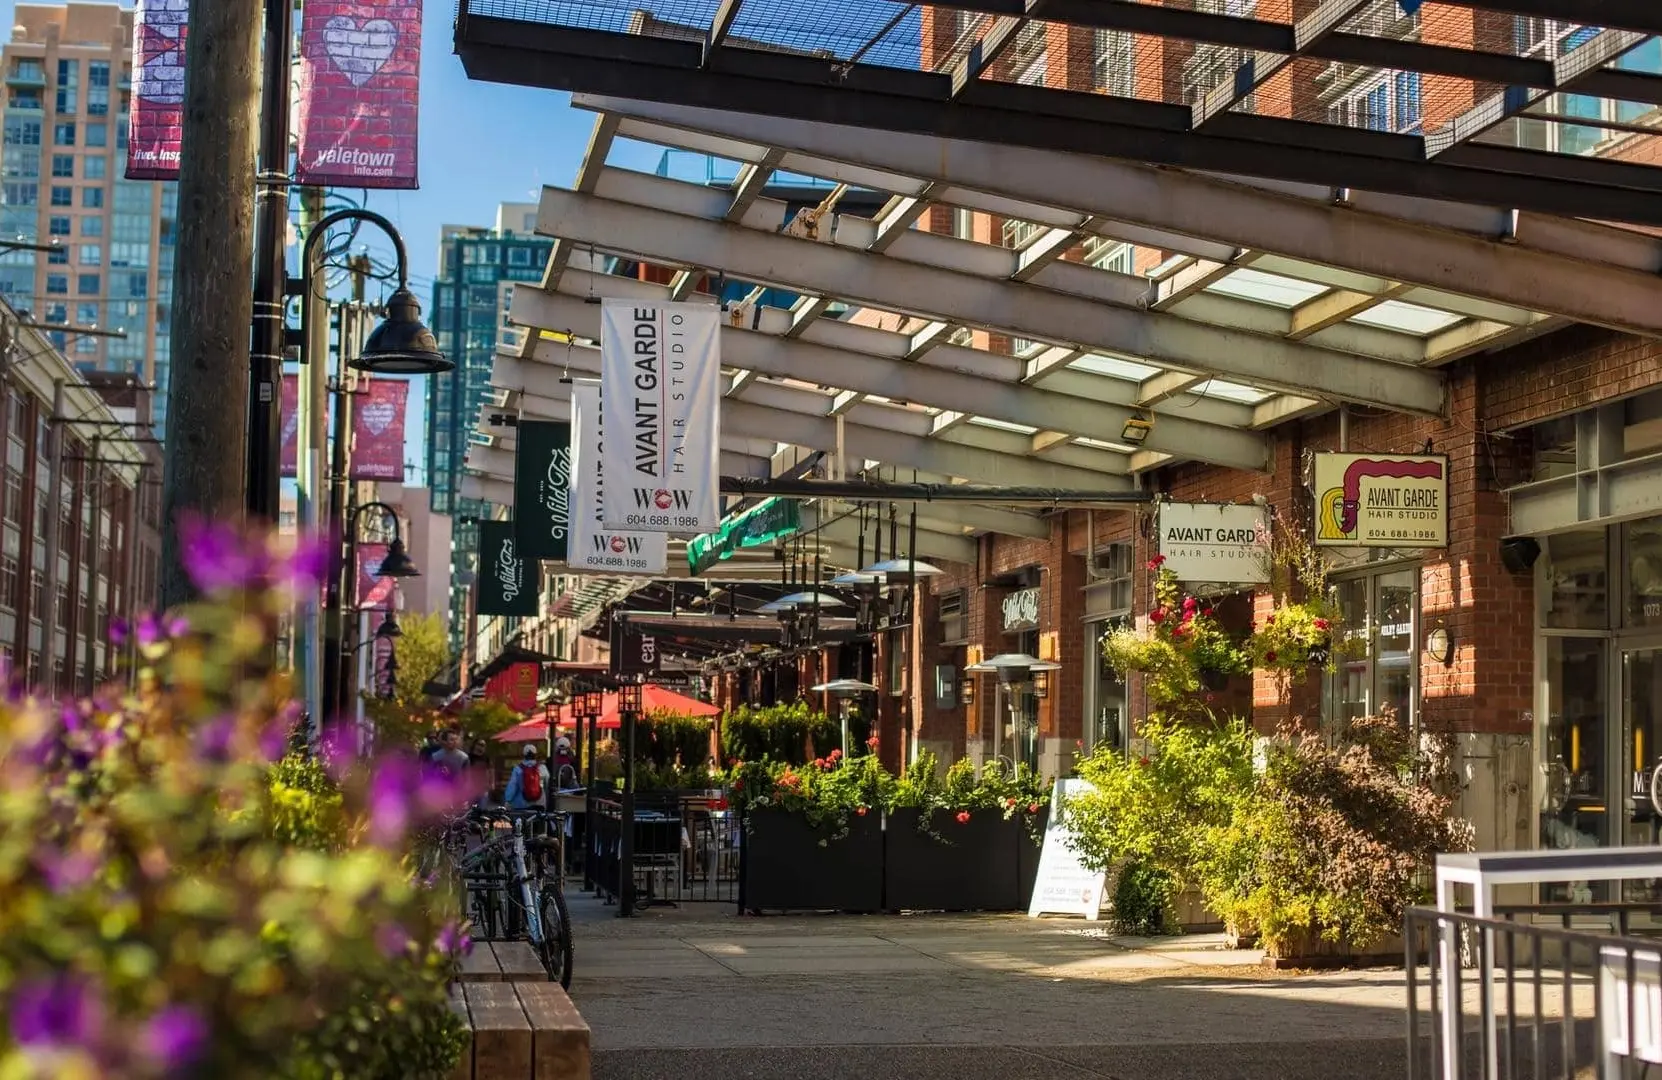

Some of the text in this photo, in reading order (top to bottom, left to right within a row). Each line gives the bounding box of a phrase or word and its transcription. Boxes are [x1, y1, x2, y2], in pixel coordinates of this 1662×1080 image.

[315, 147, 395, 167] yaletown
[354, 165, 393, 176] info.com
[634, 308, 658, 477] AVANT GARDE
[671, 314, 685, 473] HAIR STUDIO
[633, 488, 693, 511] WOW
[1367, 488, 1438, 508] AVANT GARDE
[627, 514, 699, 527] 604.688.1986
[1368, 510, 1438, 520] HAIR STUDIO
[1167, 527, 1263, 543] AVANT GARD
[1368, 529, 1386, 537] 604
[593, 534, 643, 554] WOW
[1170, 549, 1262, 559] HAIR STUDIO
[587, 556, 648, 569] 604.688.1986
[1643, 603, 1661, 617] 1073
